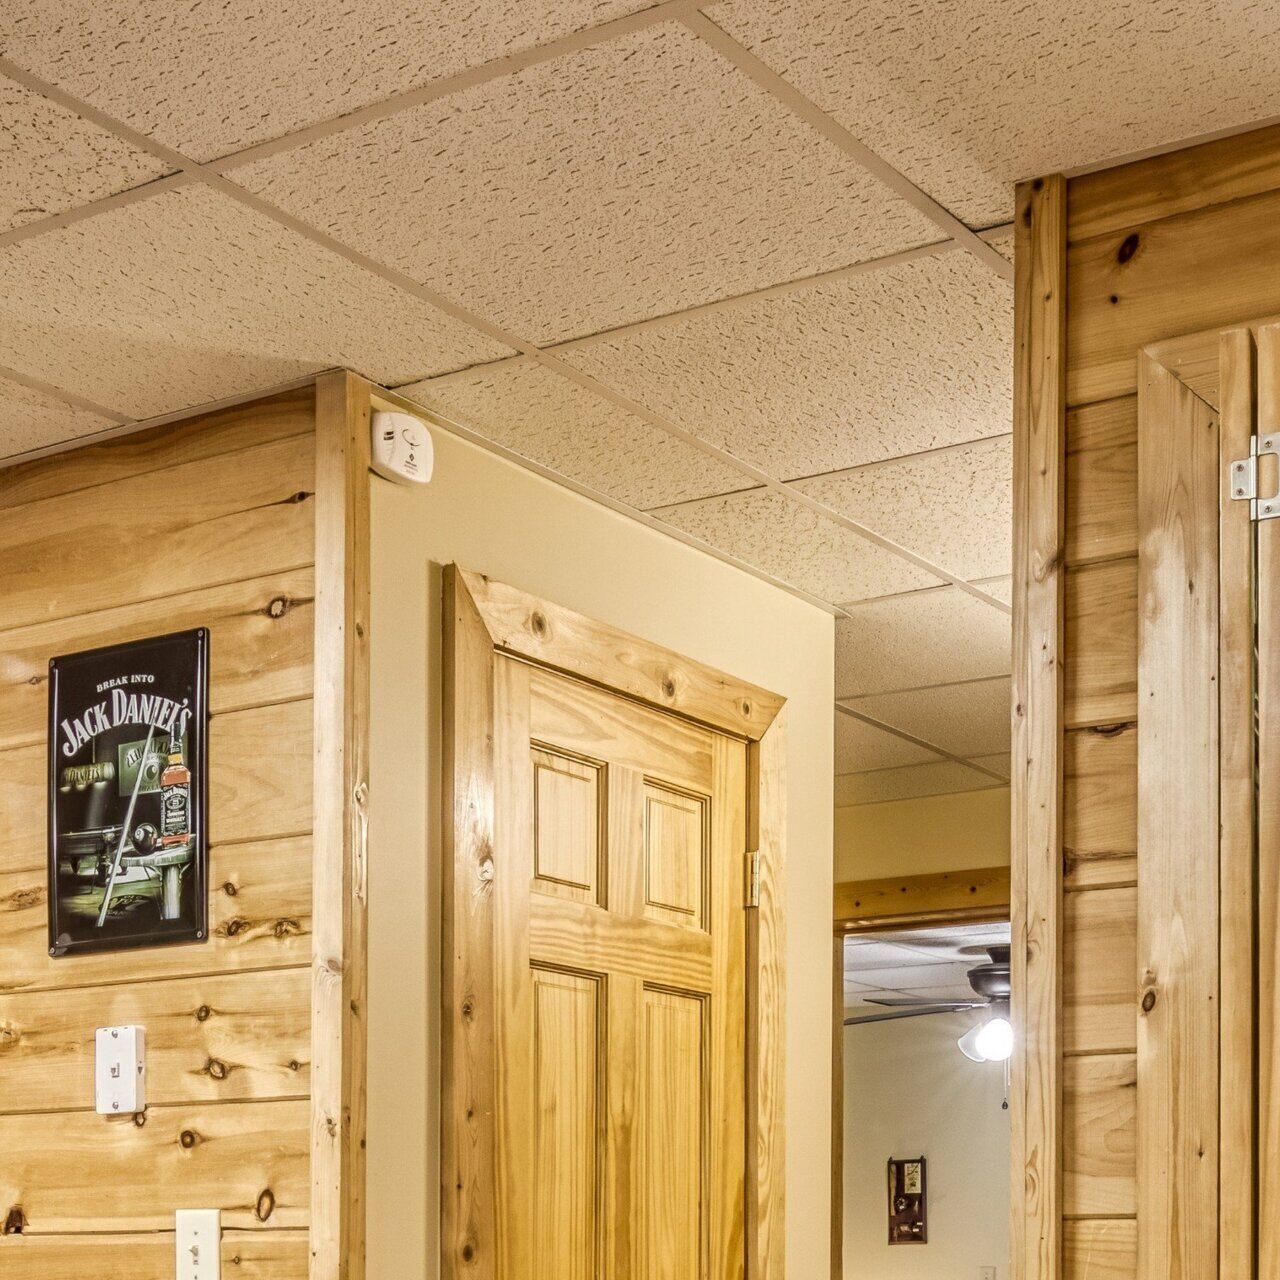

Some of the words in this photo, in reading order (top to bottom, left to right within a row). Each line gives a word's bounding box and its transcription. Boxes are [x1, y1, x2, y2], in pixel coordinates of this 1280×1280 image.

[96, 675, 128, 693] BREAK
[130, 674, 155, 683] INTO
[60, 701, 112, 757] JACK
[112, 688, 193, 738] DANIEL'S
